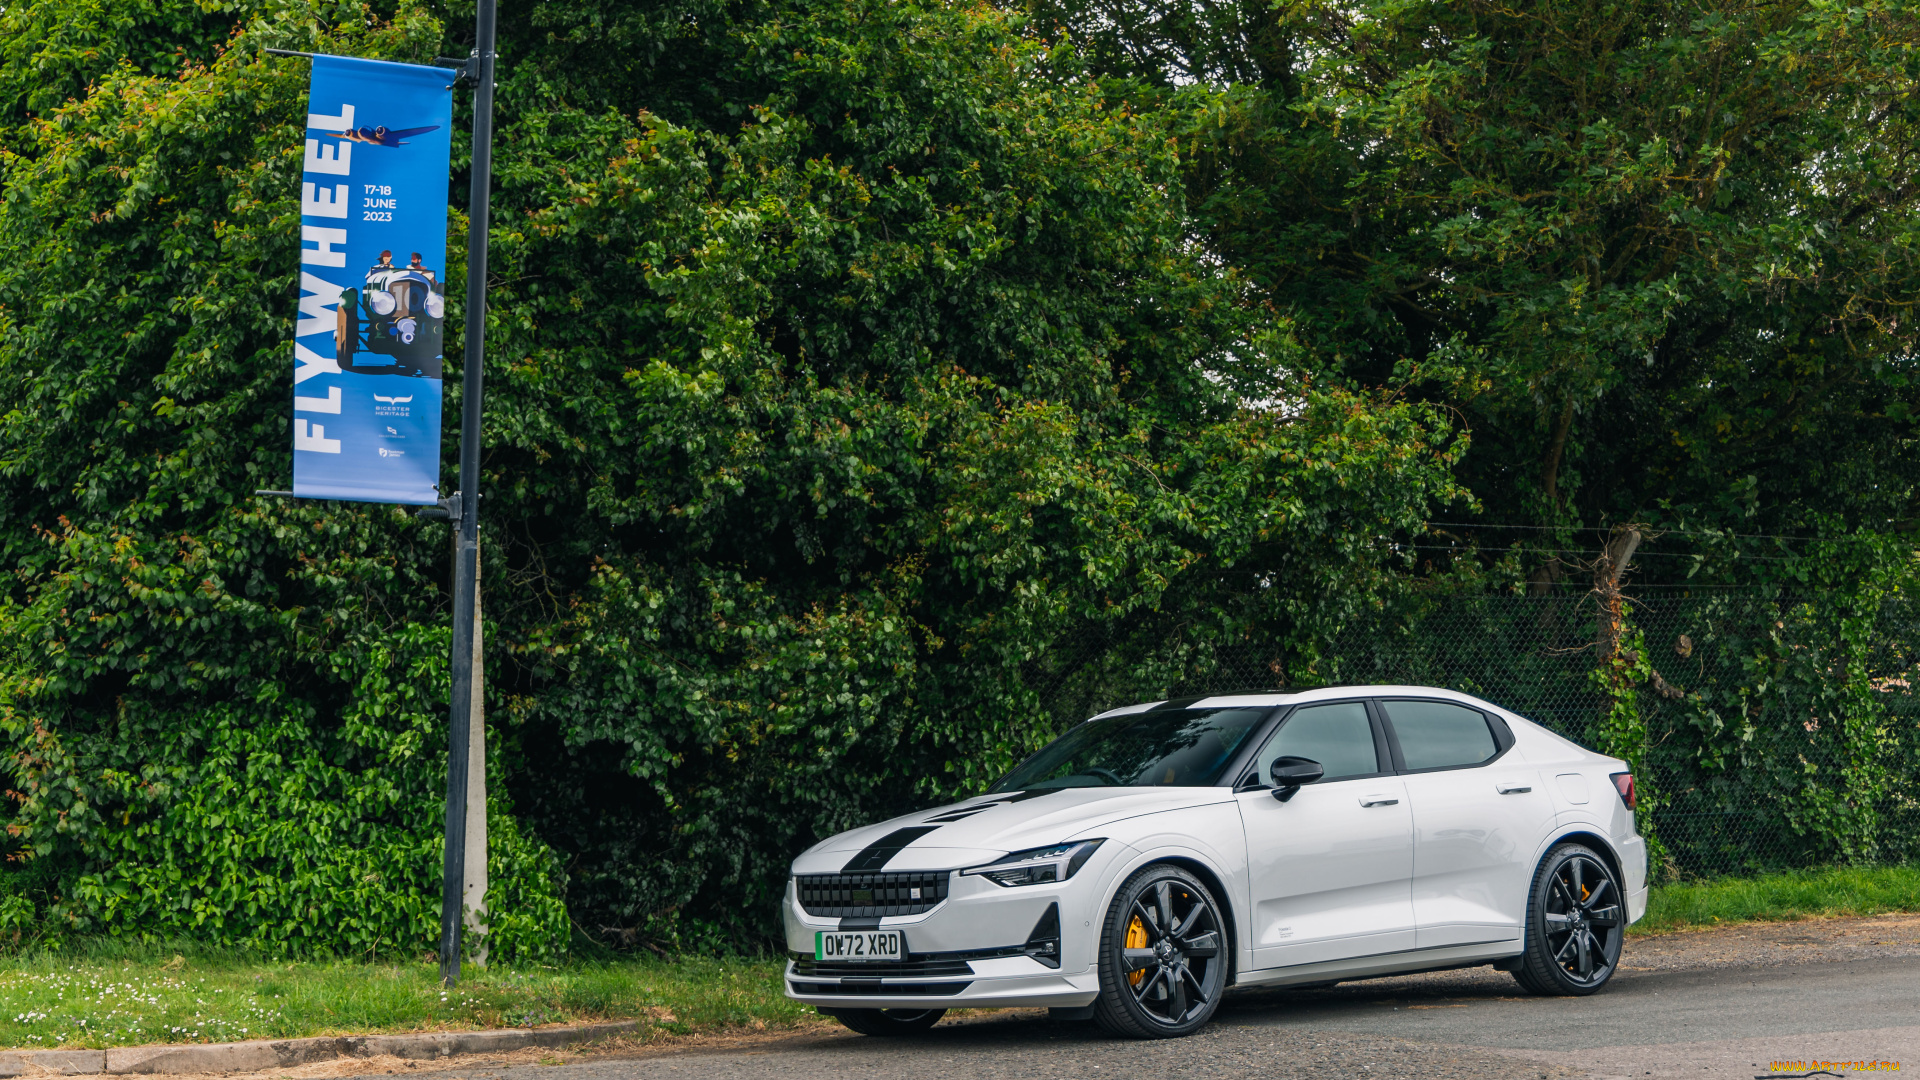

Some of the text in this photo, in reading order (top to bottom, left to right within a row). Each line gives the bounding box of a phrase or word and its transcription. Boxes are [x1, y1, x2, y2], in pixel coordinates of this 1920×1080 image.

[364, 184, 392, 196] 17-18
[363, 197, 397, 209] JUNE
[363, 211, 392, 222] 2023
[294, 103, 355, 454] FLYWHEEL
[825, 933, 898, 956] OW72 XRD
